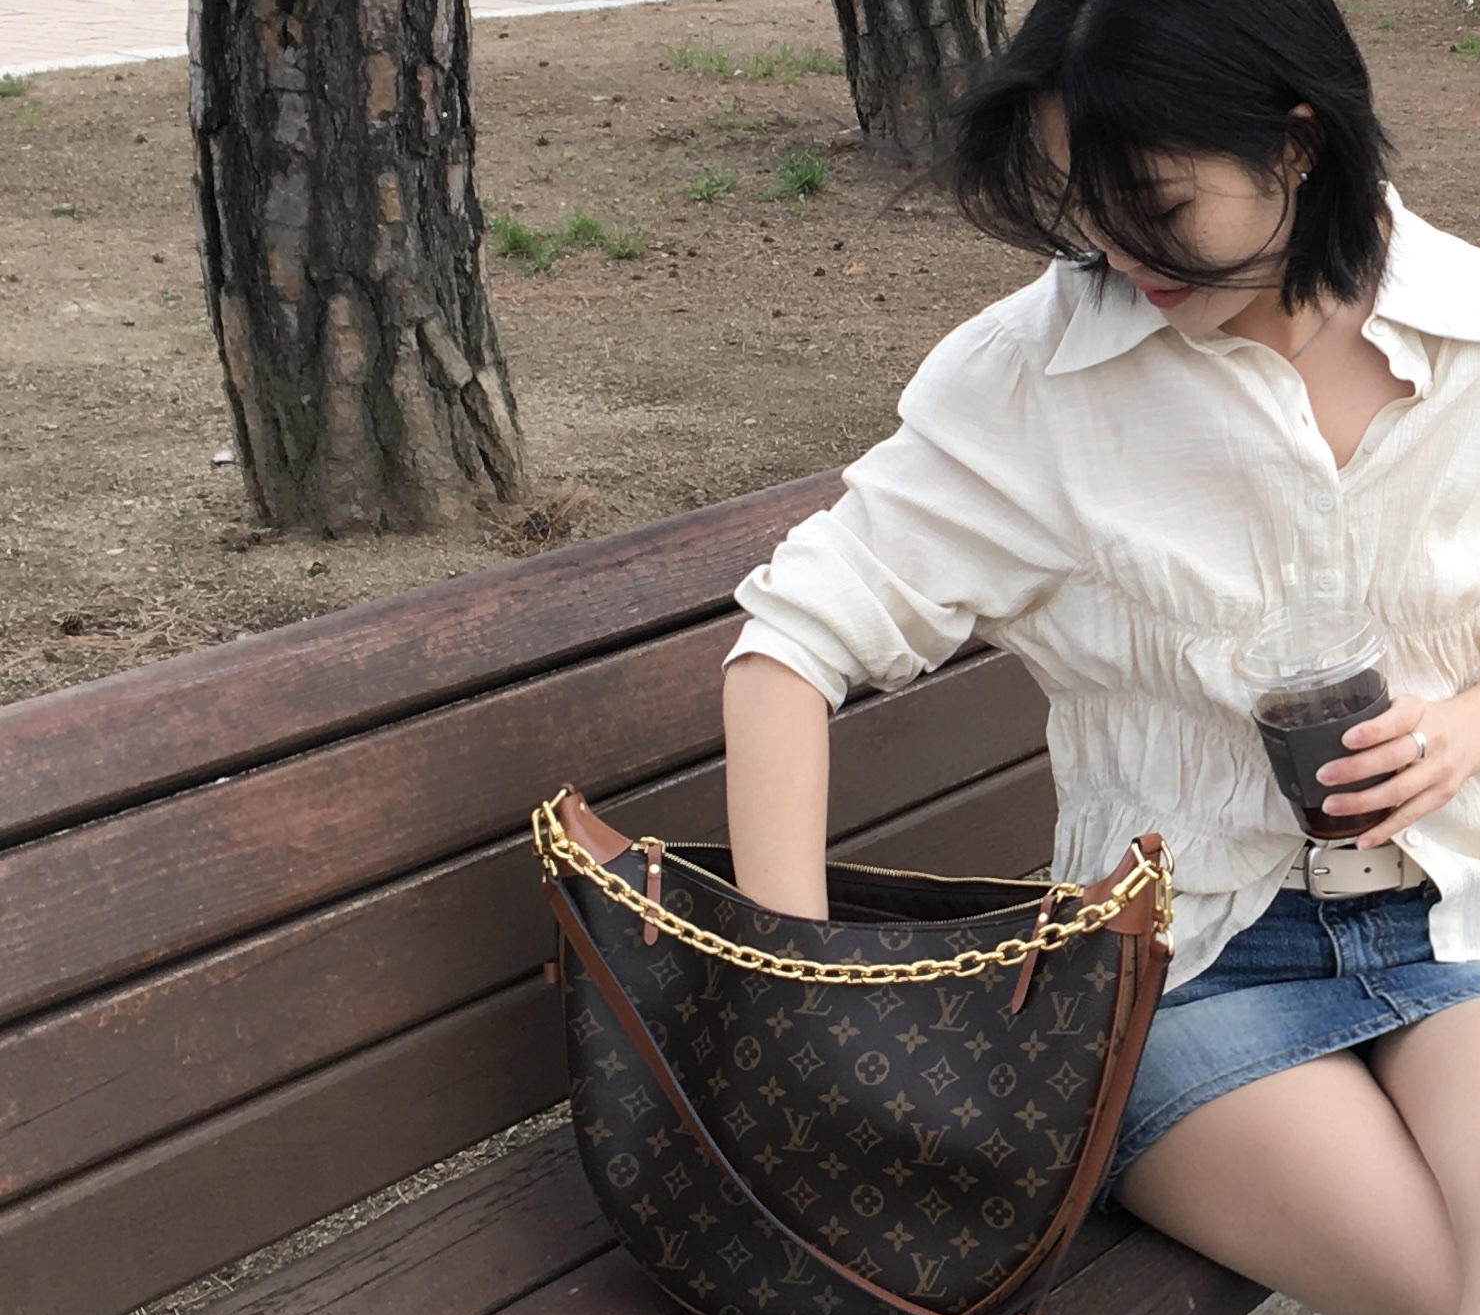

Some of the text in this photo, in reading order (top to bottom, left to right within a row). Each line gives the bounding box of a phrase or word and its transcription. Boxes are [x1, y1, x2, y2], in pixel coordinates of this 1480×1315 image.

[929, 987, 975, 1032] LV
[1046, 992, 1085, 1034] LV
[782, 1108, 820, 1152] LV
[910, 1122, 950, 1166] LV
[655, 1226, 690, 1270] LV
[908, 1252, 950, 1298] LV
